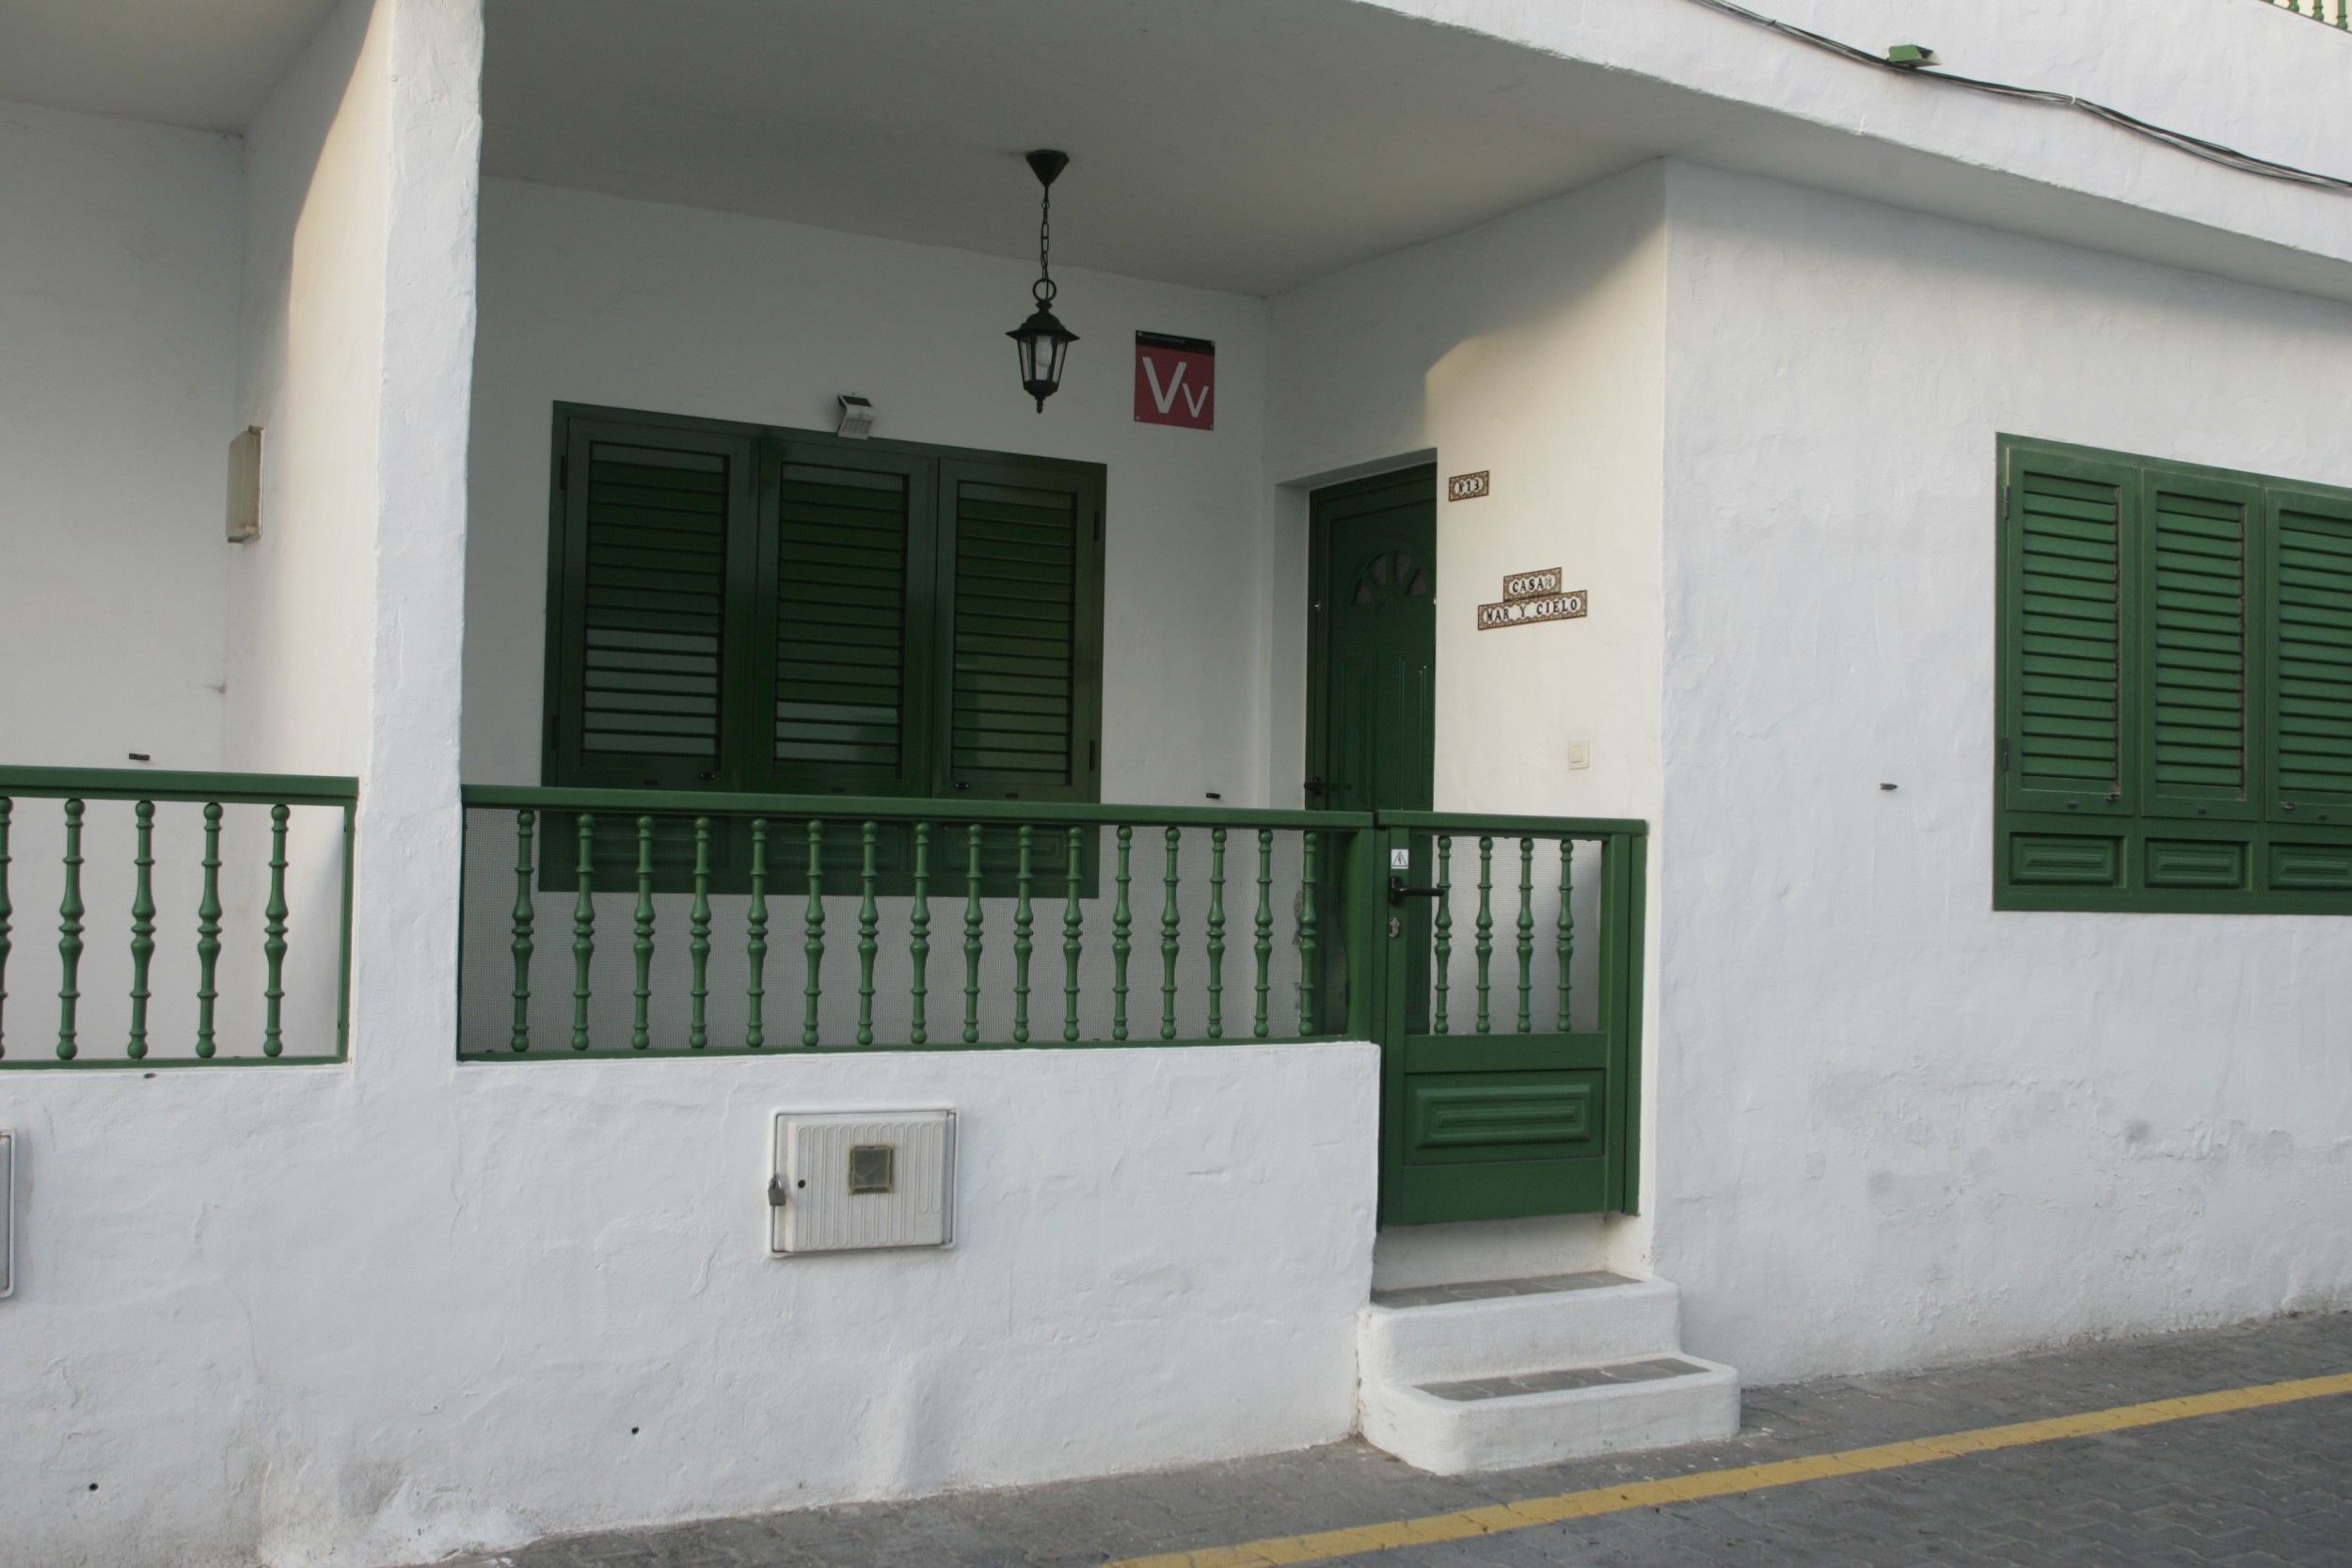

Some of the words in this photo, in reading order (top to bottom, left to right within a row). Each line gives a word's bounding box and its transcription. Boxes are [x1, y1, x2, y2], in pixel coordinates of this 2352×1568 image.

[1512, 577, 1544, 593] CASA
[1486, 608, 1509, 622] MAR
[1519, 605, 1527, 618] Y
[1536, 598, 1578, 615] CIELO
